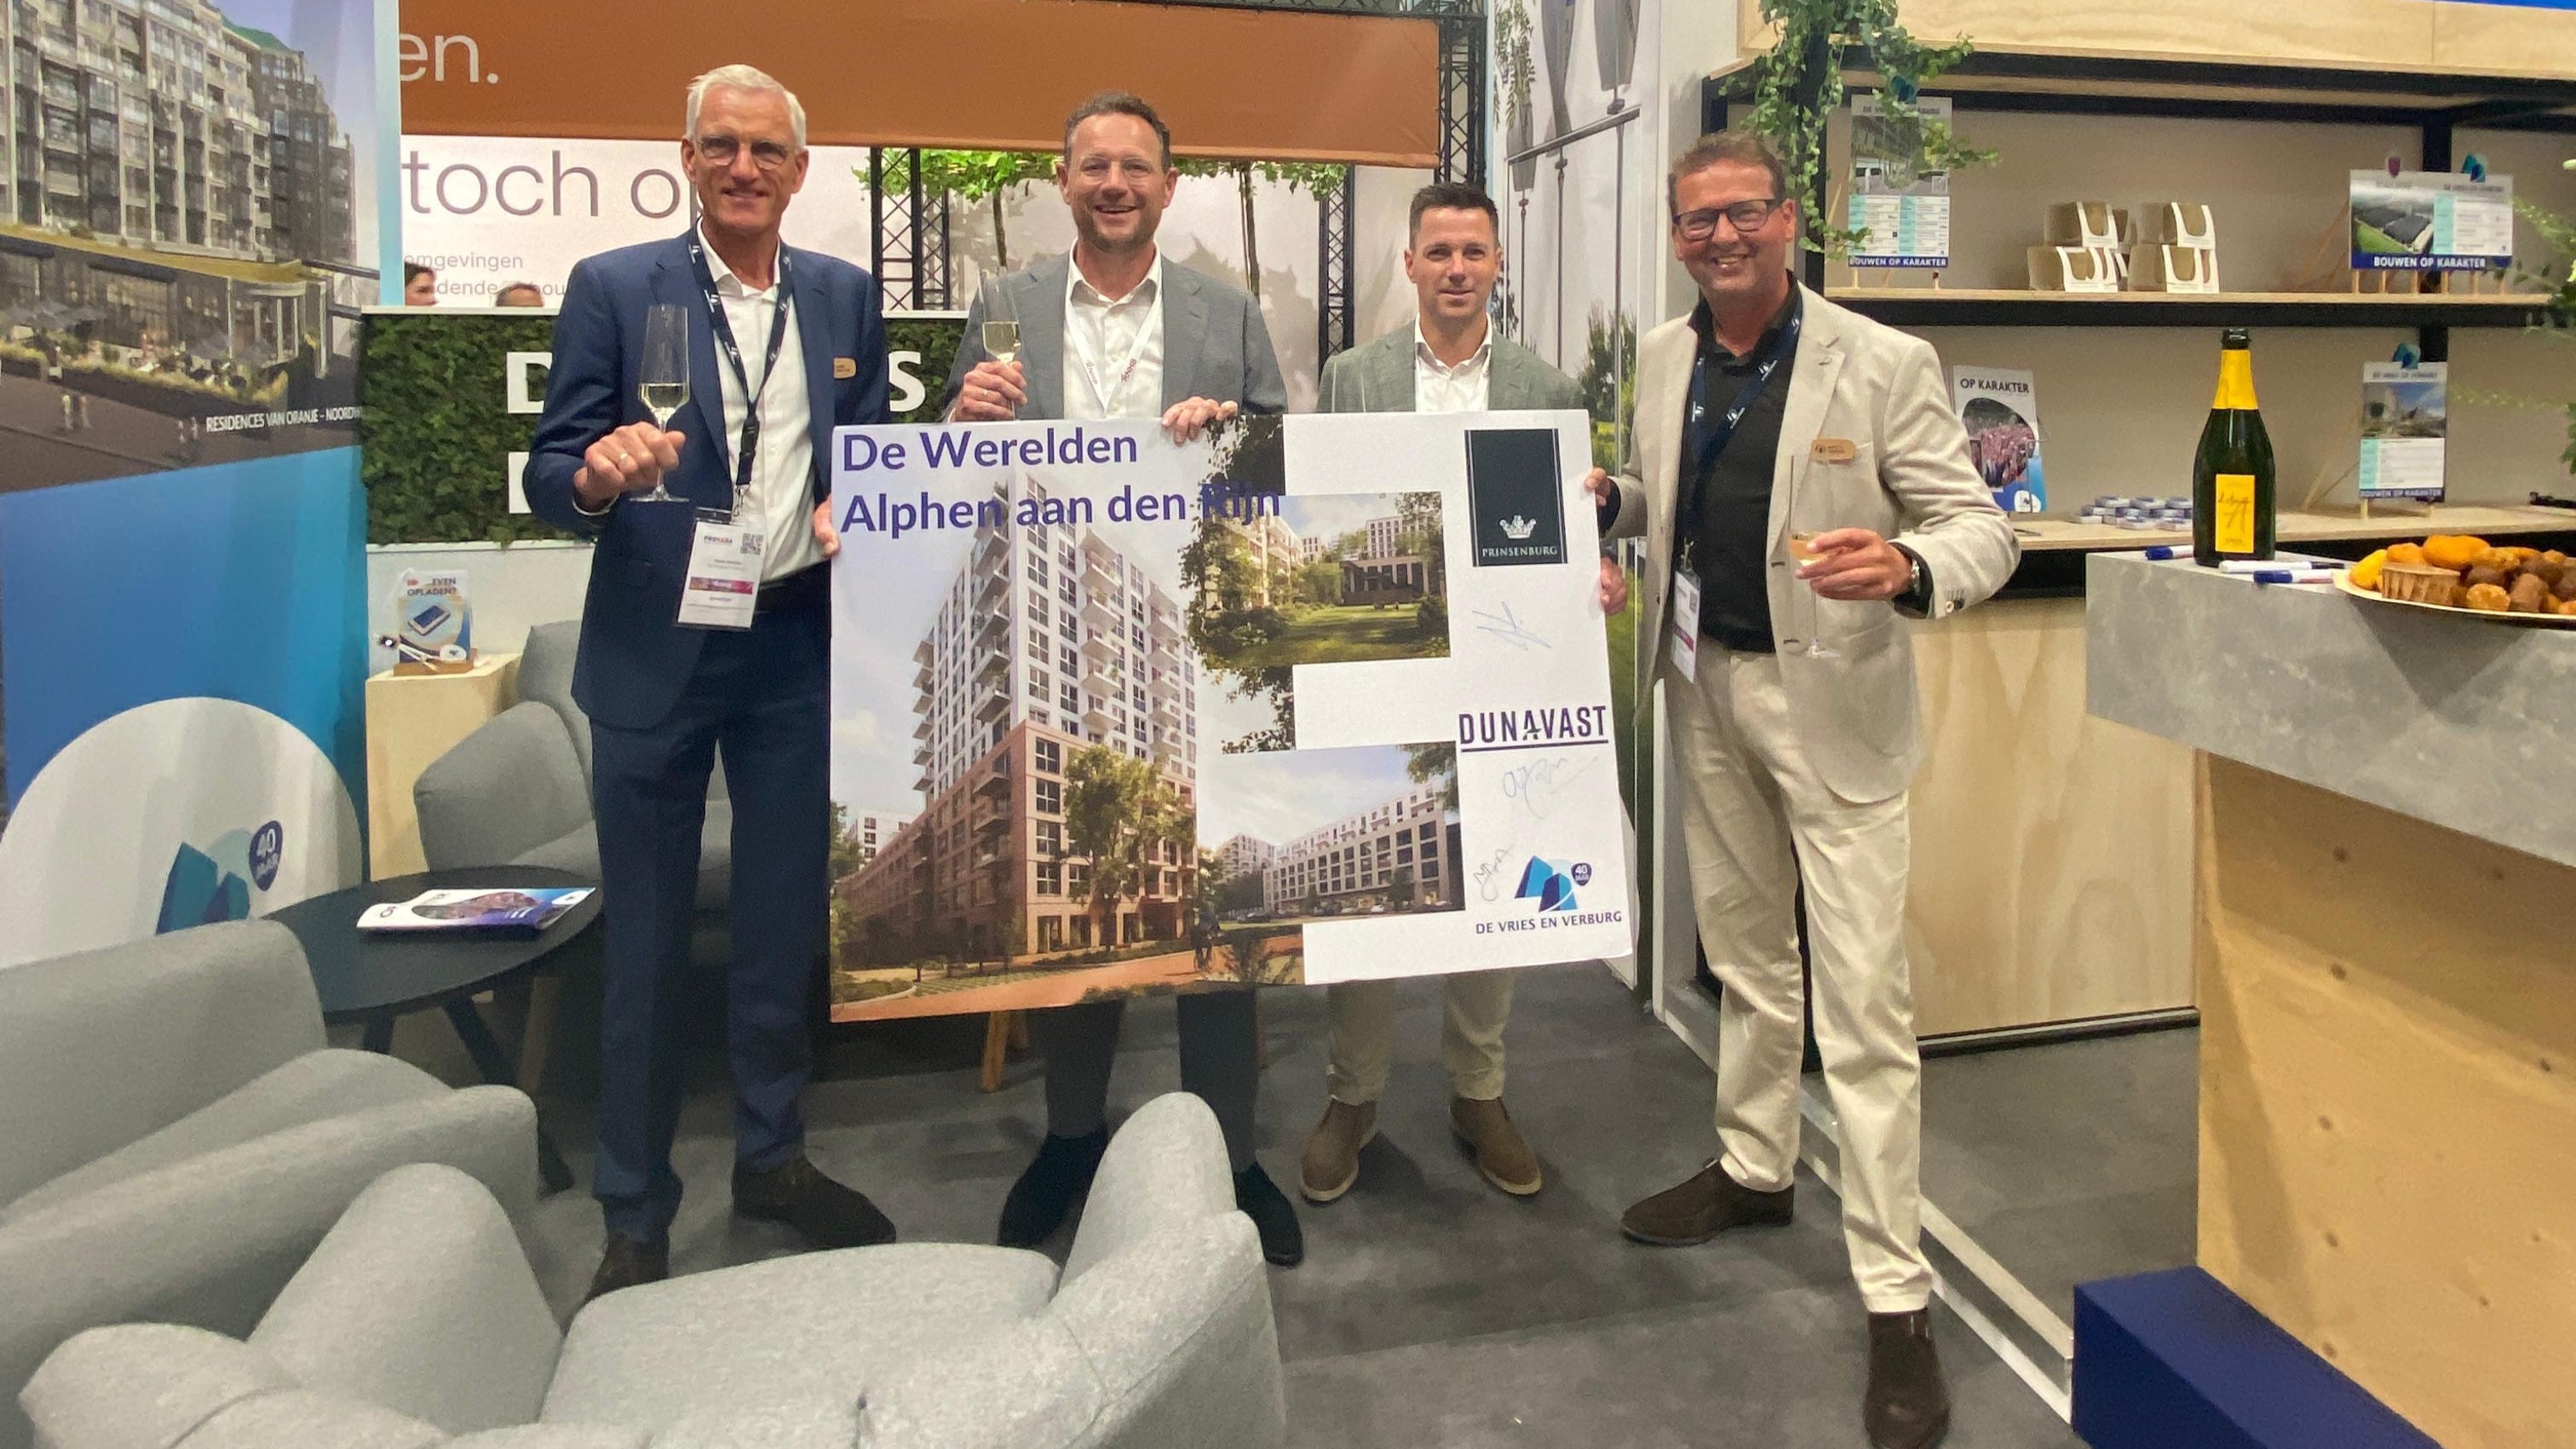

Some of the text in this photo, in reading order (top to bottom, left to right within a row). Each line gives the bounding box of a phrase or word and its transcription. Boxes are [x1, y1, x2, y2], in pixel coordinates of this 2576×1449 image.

[401, 149, 599, 217] toch
[1903, 258, 1946, 267] KARAKTER
[2373, 256, 2487, 268] BOUWEN OP KARAKTER
[1959, 377, 2030, 394] OP KARAKTER
[206, 412, 266, 432] RESIDENCES
[266, 411, 286, 427] VAN
[286, 408, 319, 426] ORANJE
[842, 426, 1138, 471] De Werelden
[840, 480, 1281, 540] Alphen aan den Rijn
[1481, 545, 1558, 558] PRINSENBURG
[1458, 705, 1607, 745] DUNAVAST
[1574, 865, 1588, 875] 40
[1475, 911, 1623, 934] DE VRIES EN VERBURG
